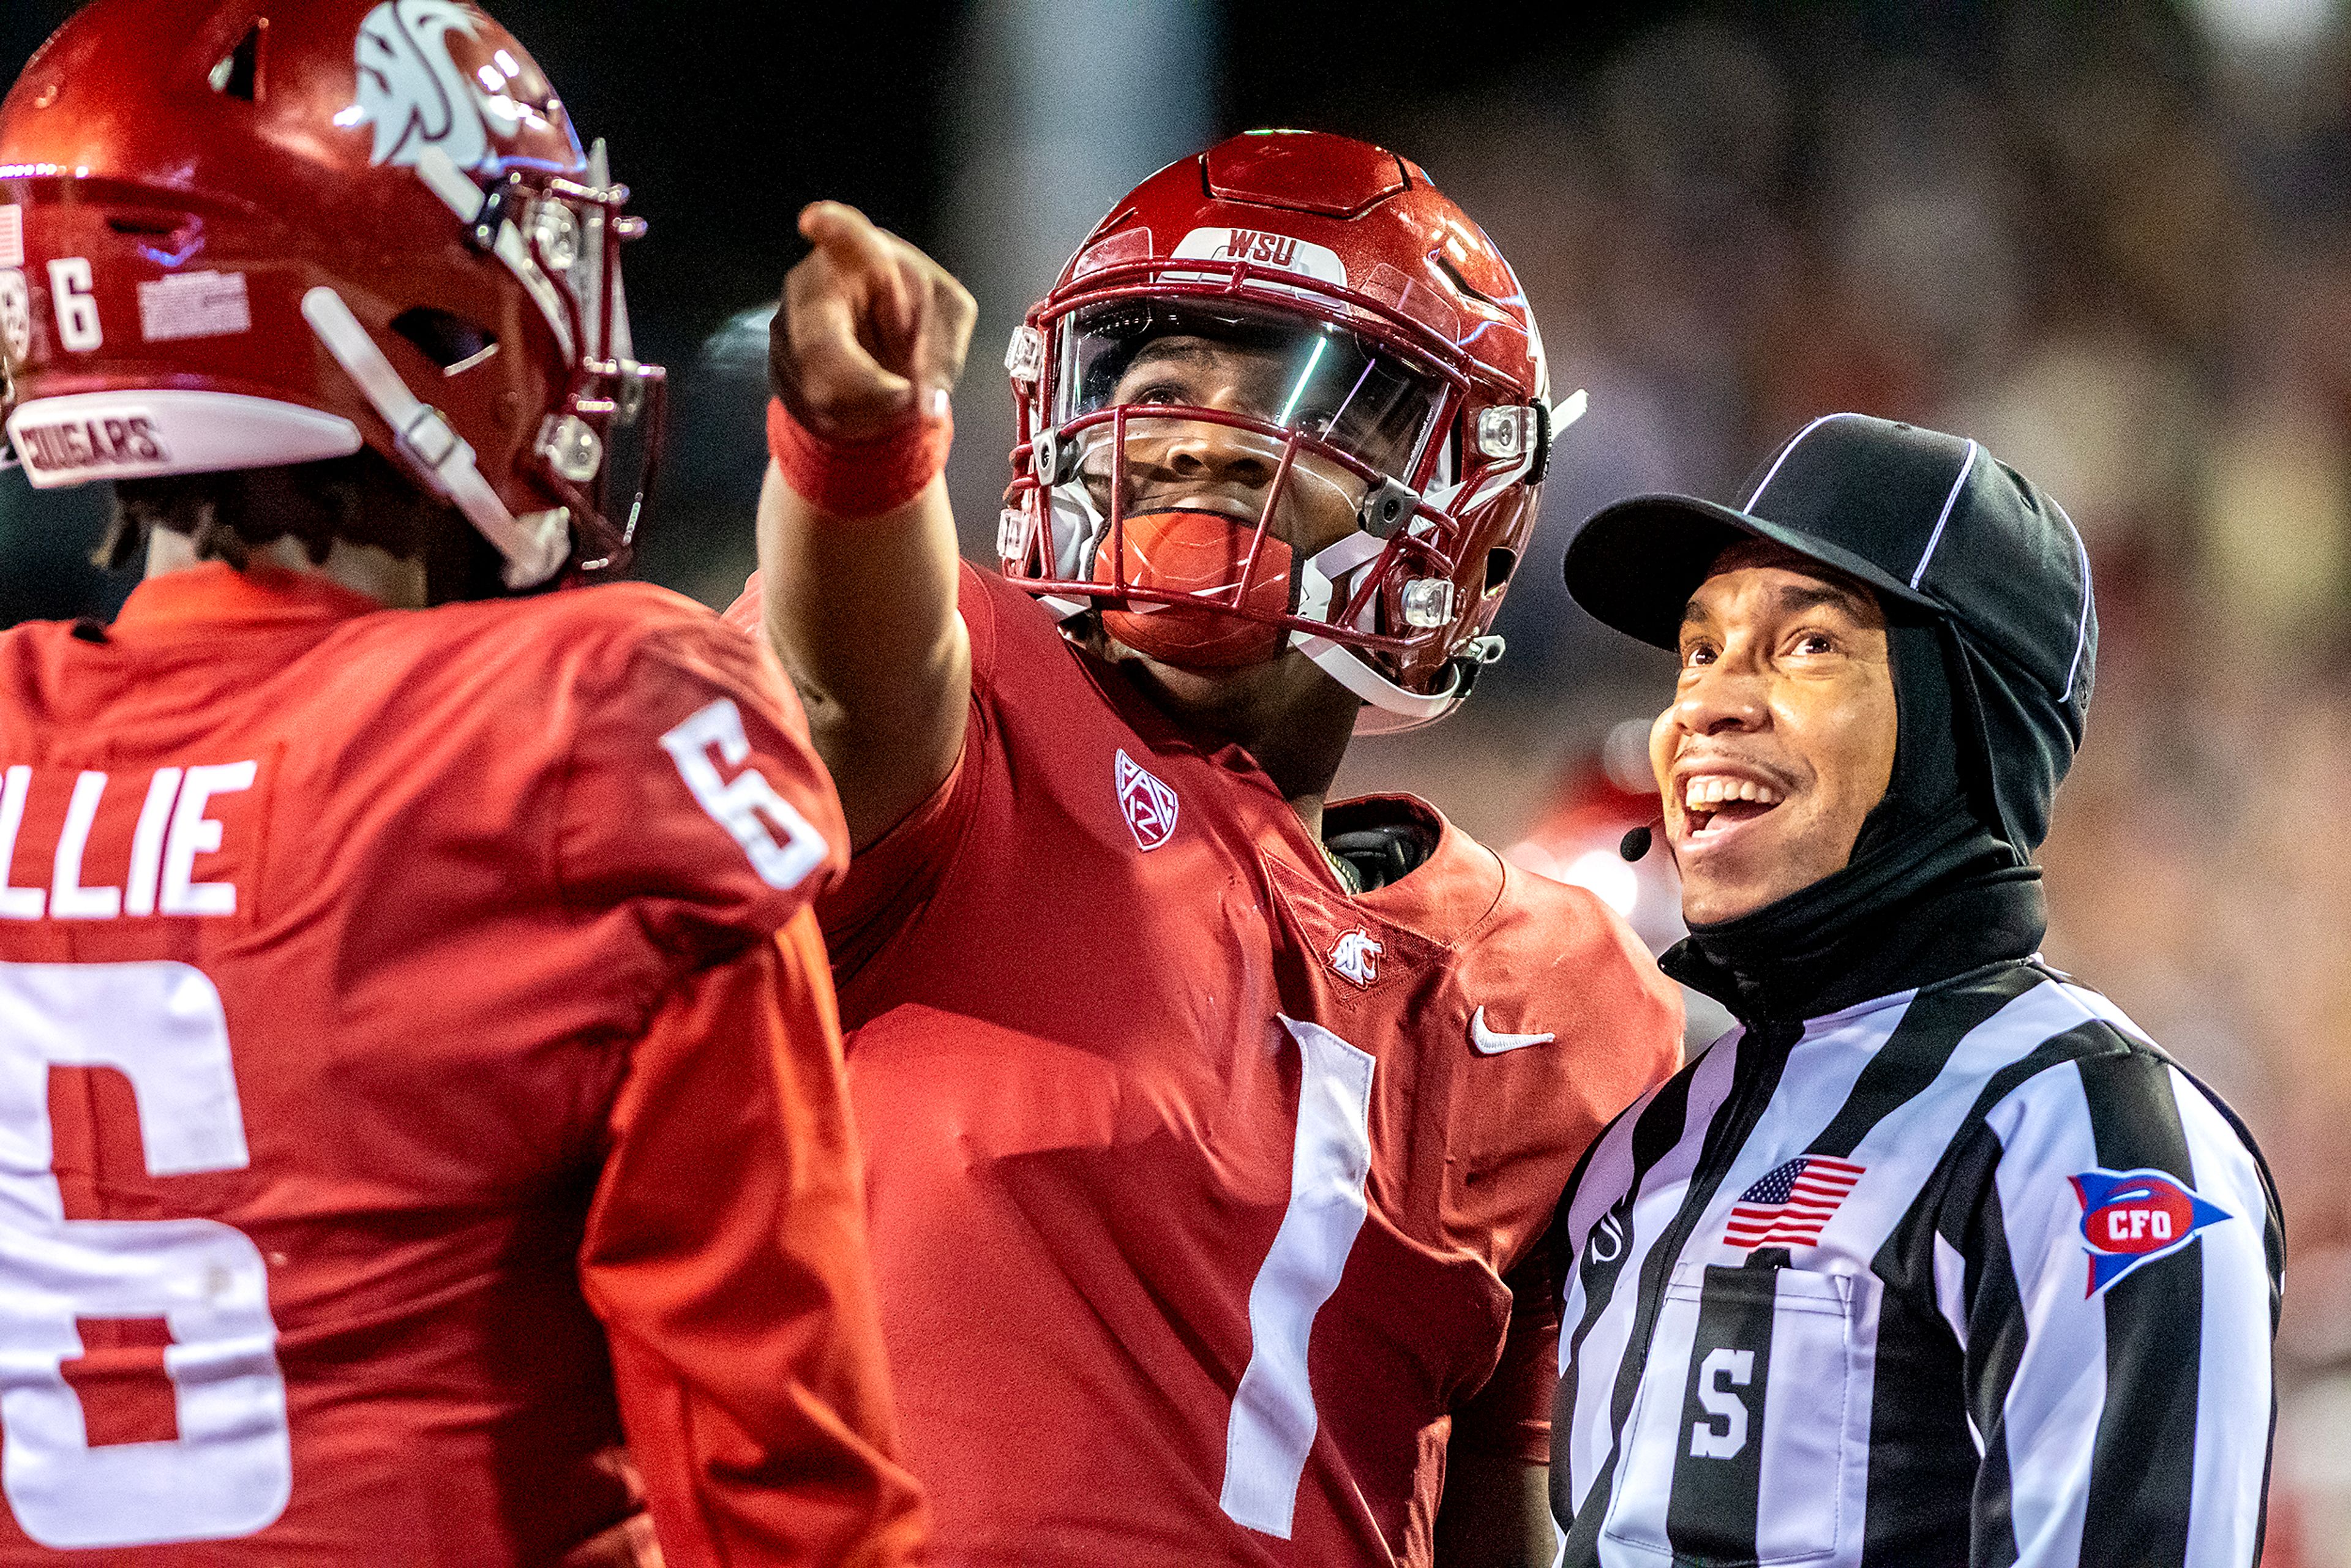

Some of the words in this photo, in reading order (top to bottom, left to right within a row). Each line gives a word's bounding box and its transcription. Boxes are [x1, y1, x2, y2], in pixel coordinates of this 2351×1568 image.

[47, 257, 103, 352] 6
[1226, 228, 1297, 266] WSU
[0, 760, 257, 920] LLIE
[659, 697, 830, 890] 6
[0, 959, 293, 1550] 6
[1220, 1012, 1376, 1540] 1
[2108, 1209, 2172, 1240] CFO
[1690, 1347, 1755, 1460] S
